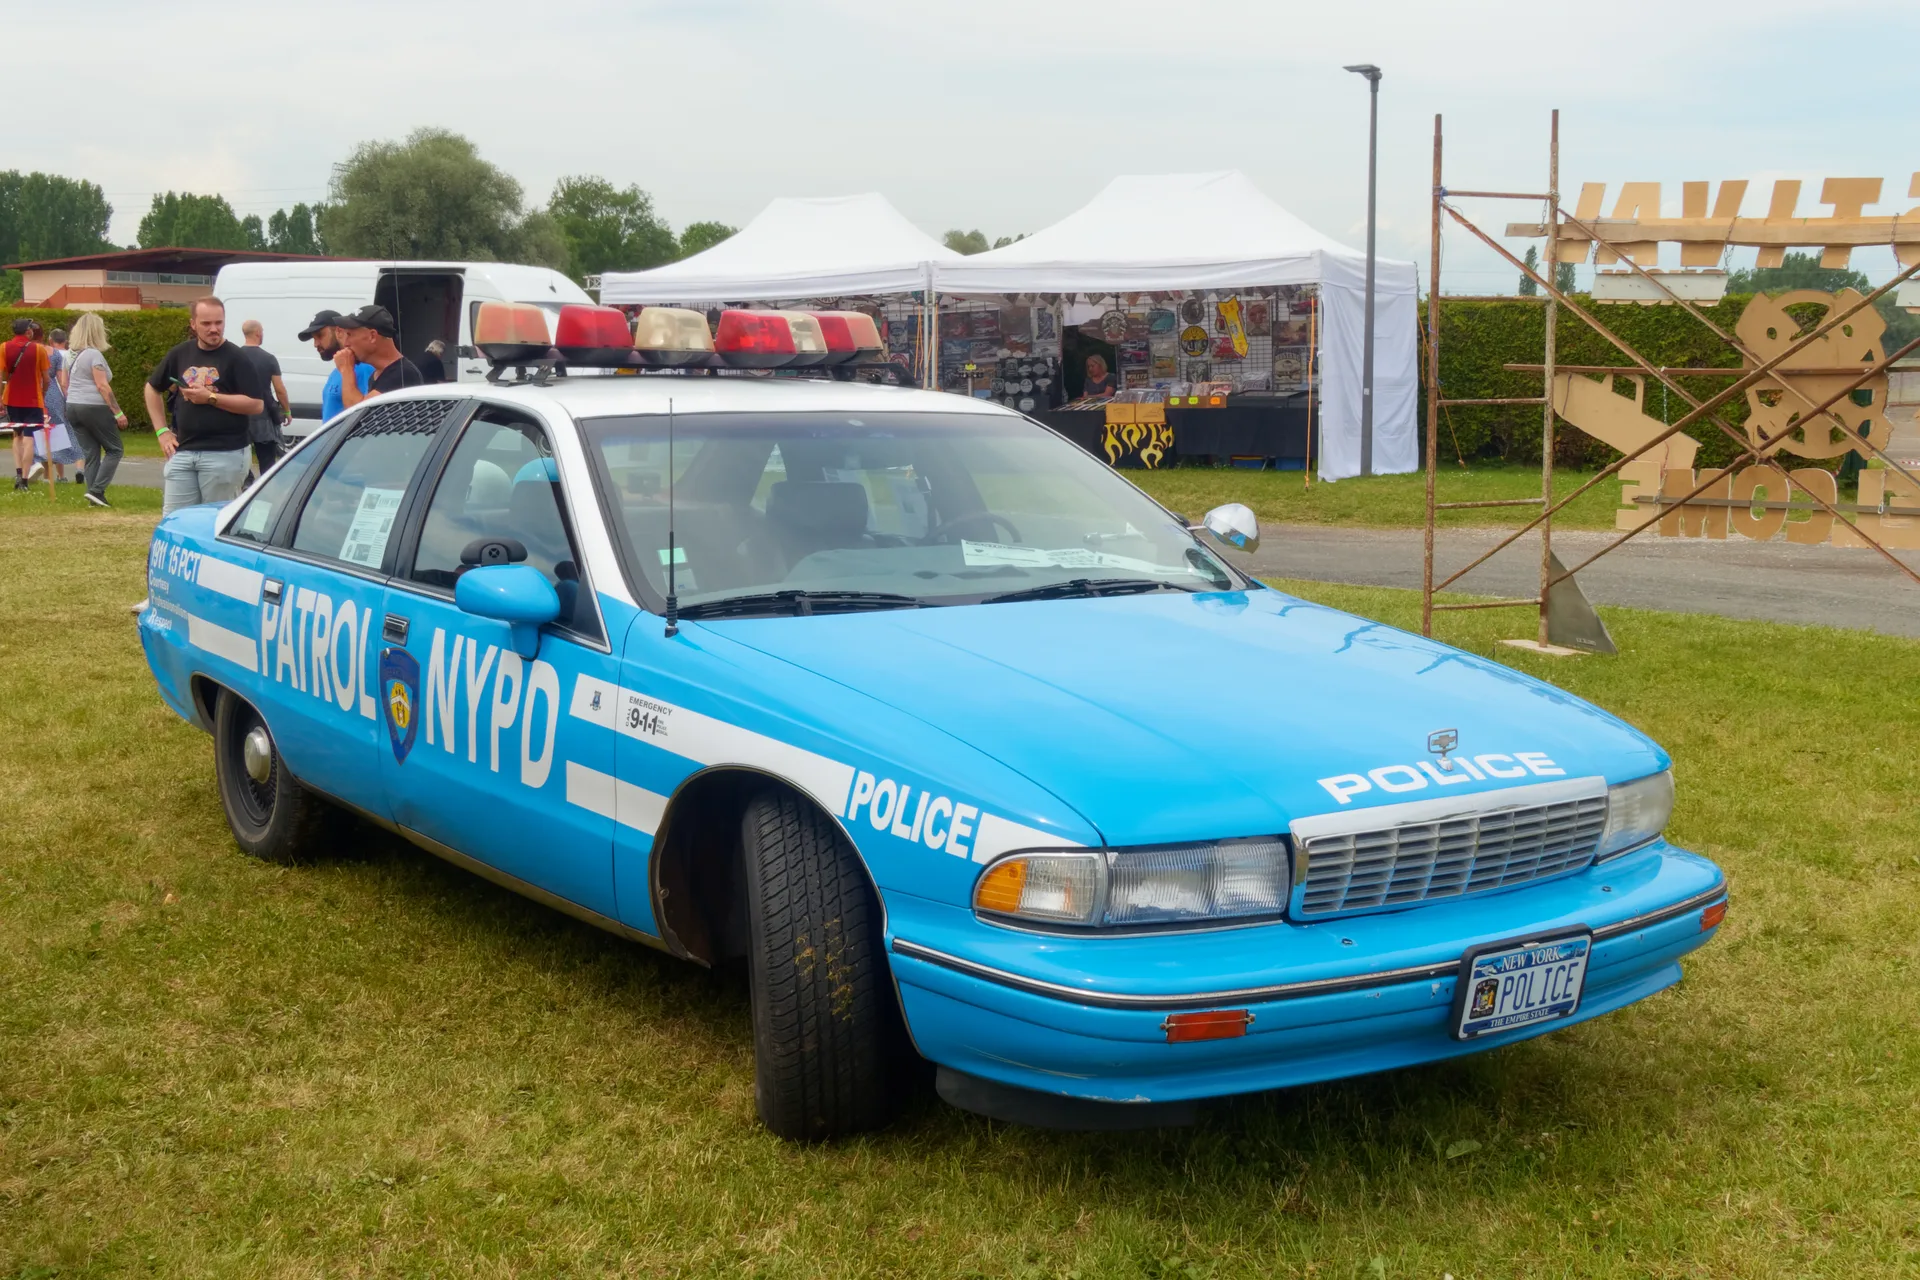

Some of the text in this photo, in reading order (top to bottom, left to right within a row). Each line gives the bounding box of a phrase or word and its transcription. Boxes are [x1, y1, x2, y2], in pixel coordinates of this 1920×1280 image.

[261, 584, 376, 721] PATROL
[426, 627, 560, 788] NYPD
[629, 696, 673, 716] EMERGENCY
[1317, 752, 1567, 804] POLICE
[848, 770, 979, 860] POLICE
[1501, 946, 1562, 972] NEW YORK
[1499, 962, 1579, 1014] POLICE
[1490, 1017, 1504, 1028] THE
[1505, 1012, 1531, 1025] EMPIRE
[1530, 1008, 1550, 1020] STATE
